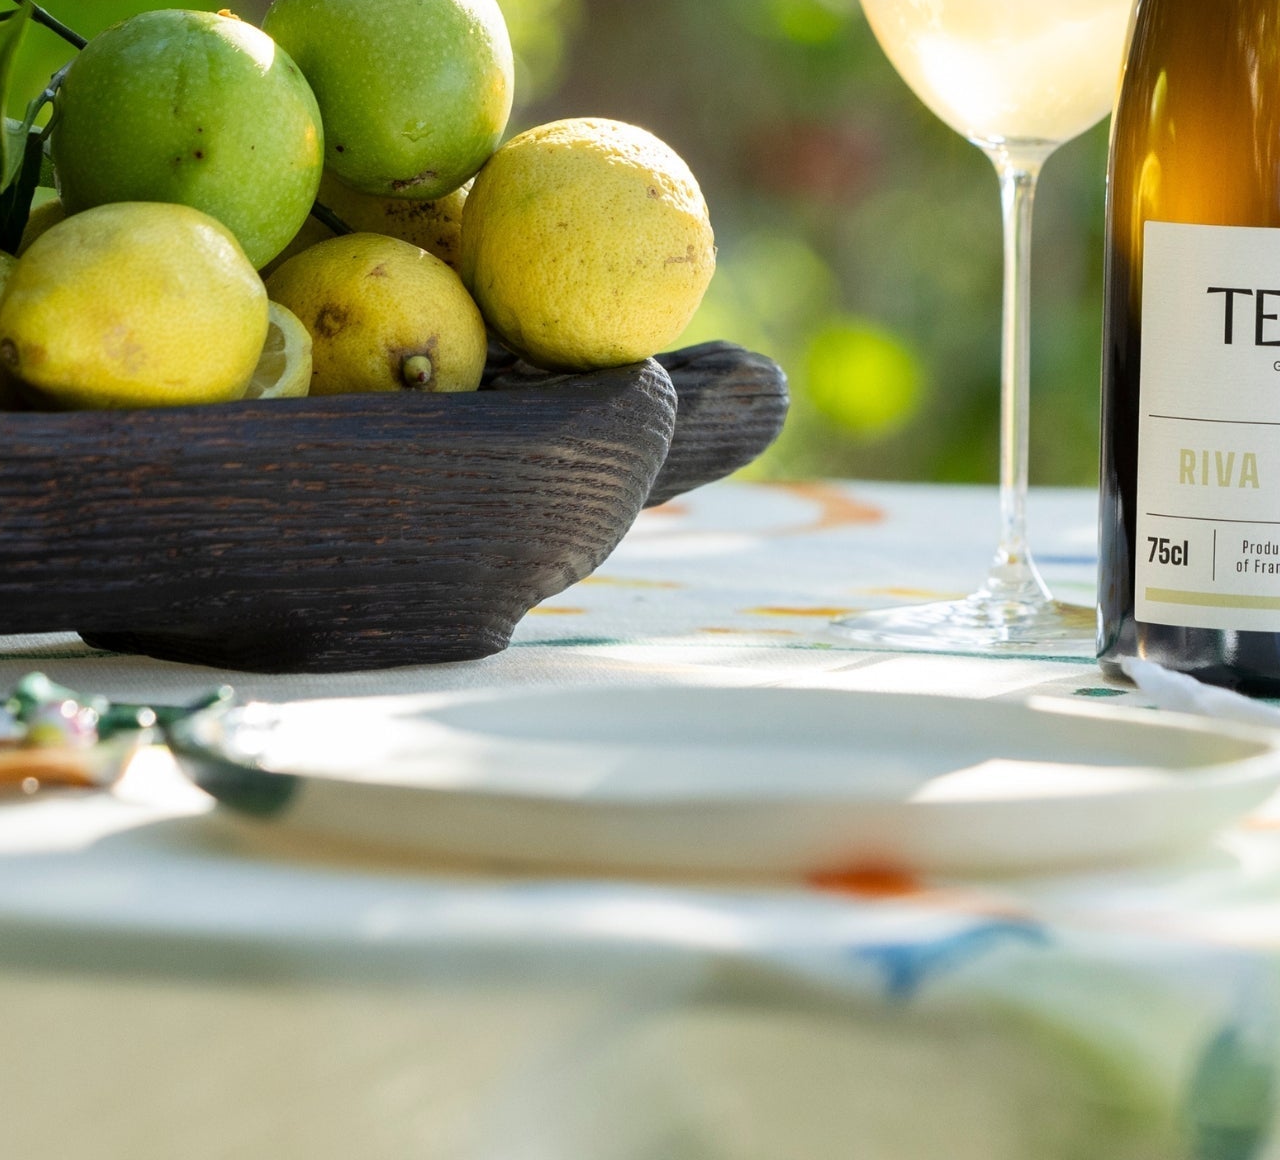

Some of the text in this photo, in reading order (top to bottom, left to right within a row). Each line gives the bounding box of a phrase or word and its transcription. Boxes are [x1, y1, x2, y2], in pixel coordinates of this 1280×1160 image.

[1178, 448, 1261, 489] RIVA
[1147, 536, 1189, 566] 75cl
[1236, 559, 1249, 573] of
